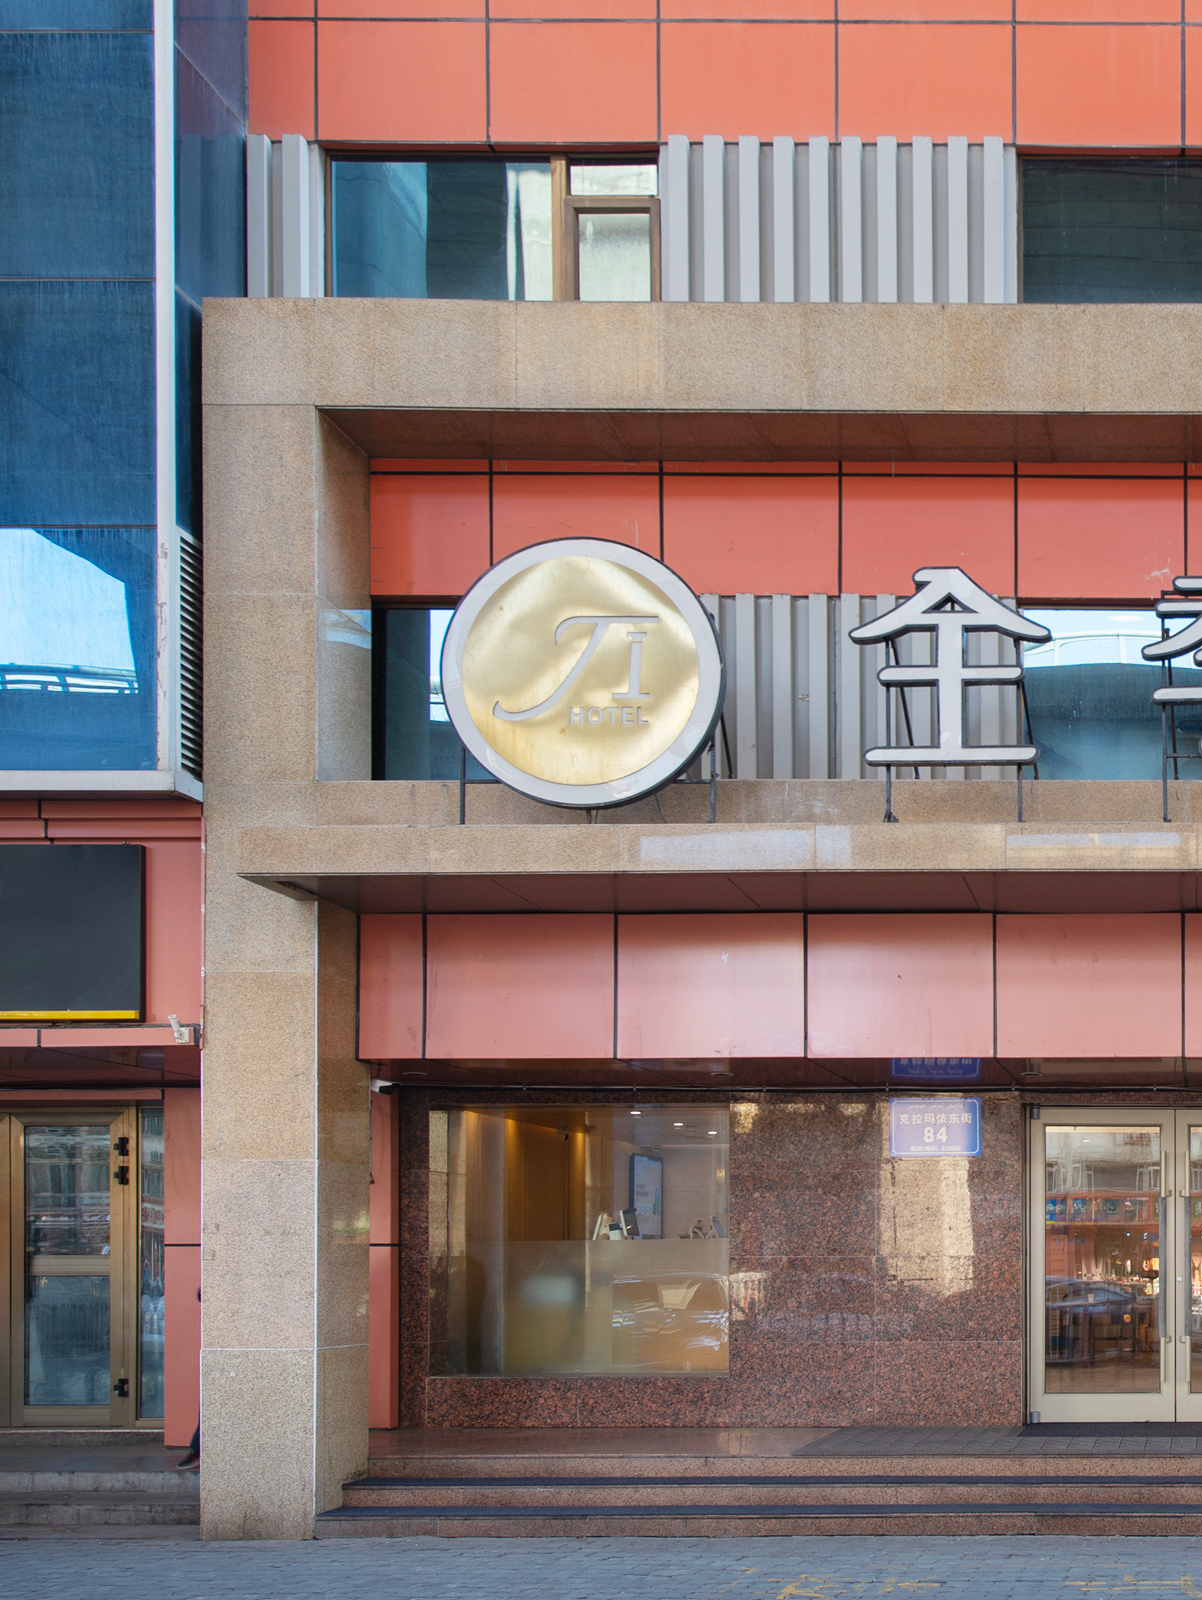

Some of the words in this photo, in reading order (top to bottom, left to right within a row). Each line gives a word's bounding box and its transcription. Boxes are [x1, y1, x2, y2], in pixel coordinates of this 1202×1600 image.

[569, 706, 649, 725] HOTEL
[899, 1113, 972, 1125] 克拉玛依东街
[923, 1126, 948, 1143] 84
